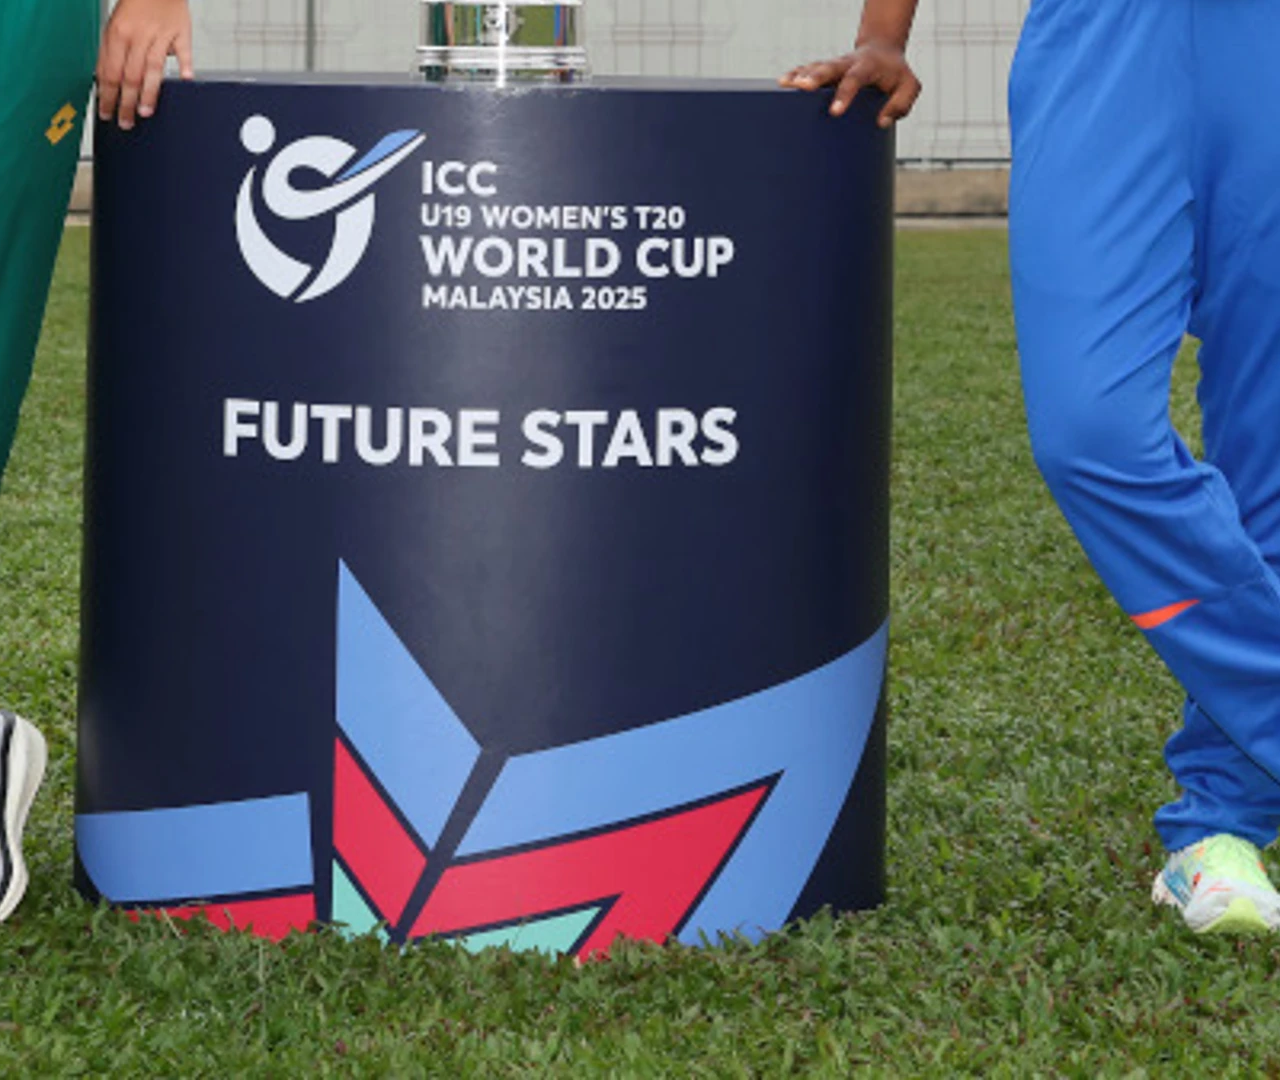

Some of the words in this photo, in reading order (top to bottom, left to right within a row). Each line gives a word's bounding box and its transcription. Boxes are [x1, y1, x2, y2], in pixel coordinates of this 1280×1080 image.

[422, 161, 498, 196] ICC
[420, 204, 473, 229] U19
[479, 204, 628, 230] WOMEN'S
[634, 205, 685, 229] T20
[419, 236, 621, 278] WORLD
[636, 237, 734, 278] CUP
[422, 284, 573, 310] MALAYSIA
[581, 286, 647, 310] 2025
[223, 398, 500, 467] FUTURE
[521, 407, 739, 469] STARS
